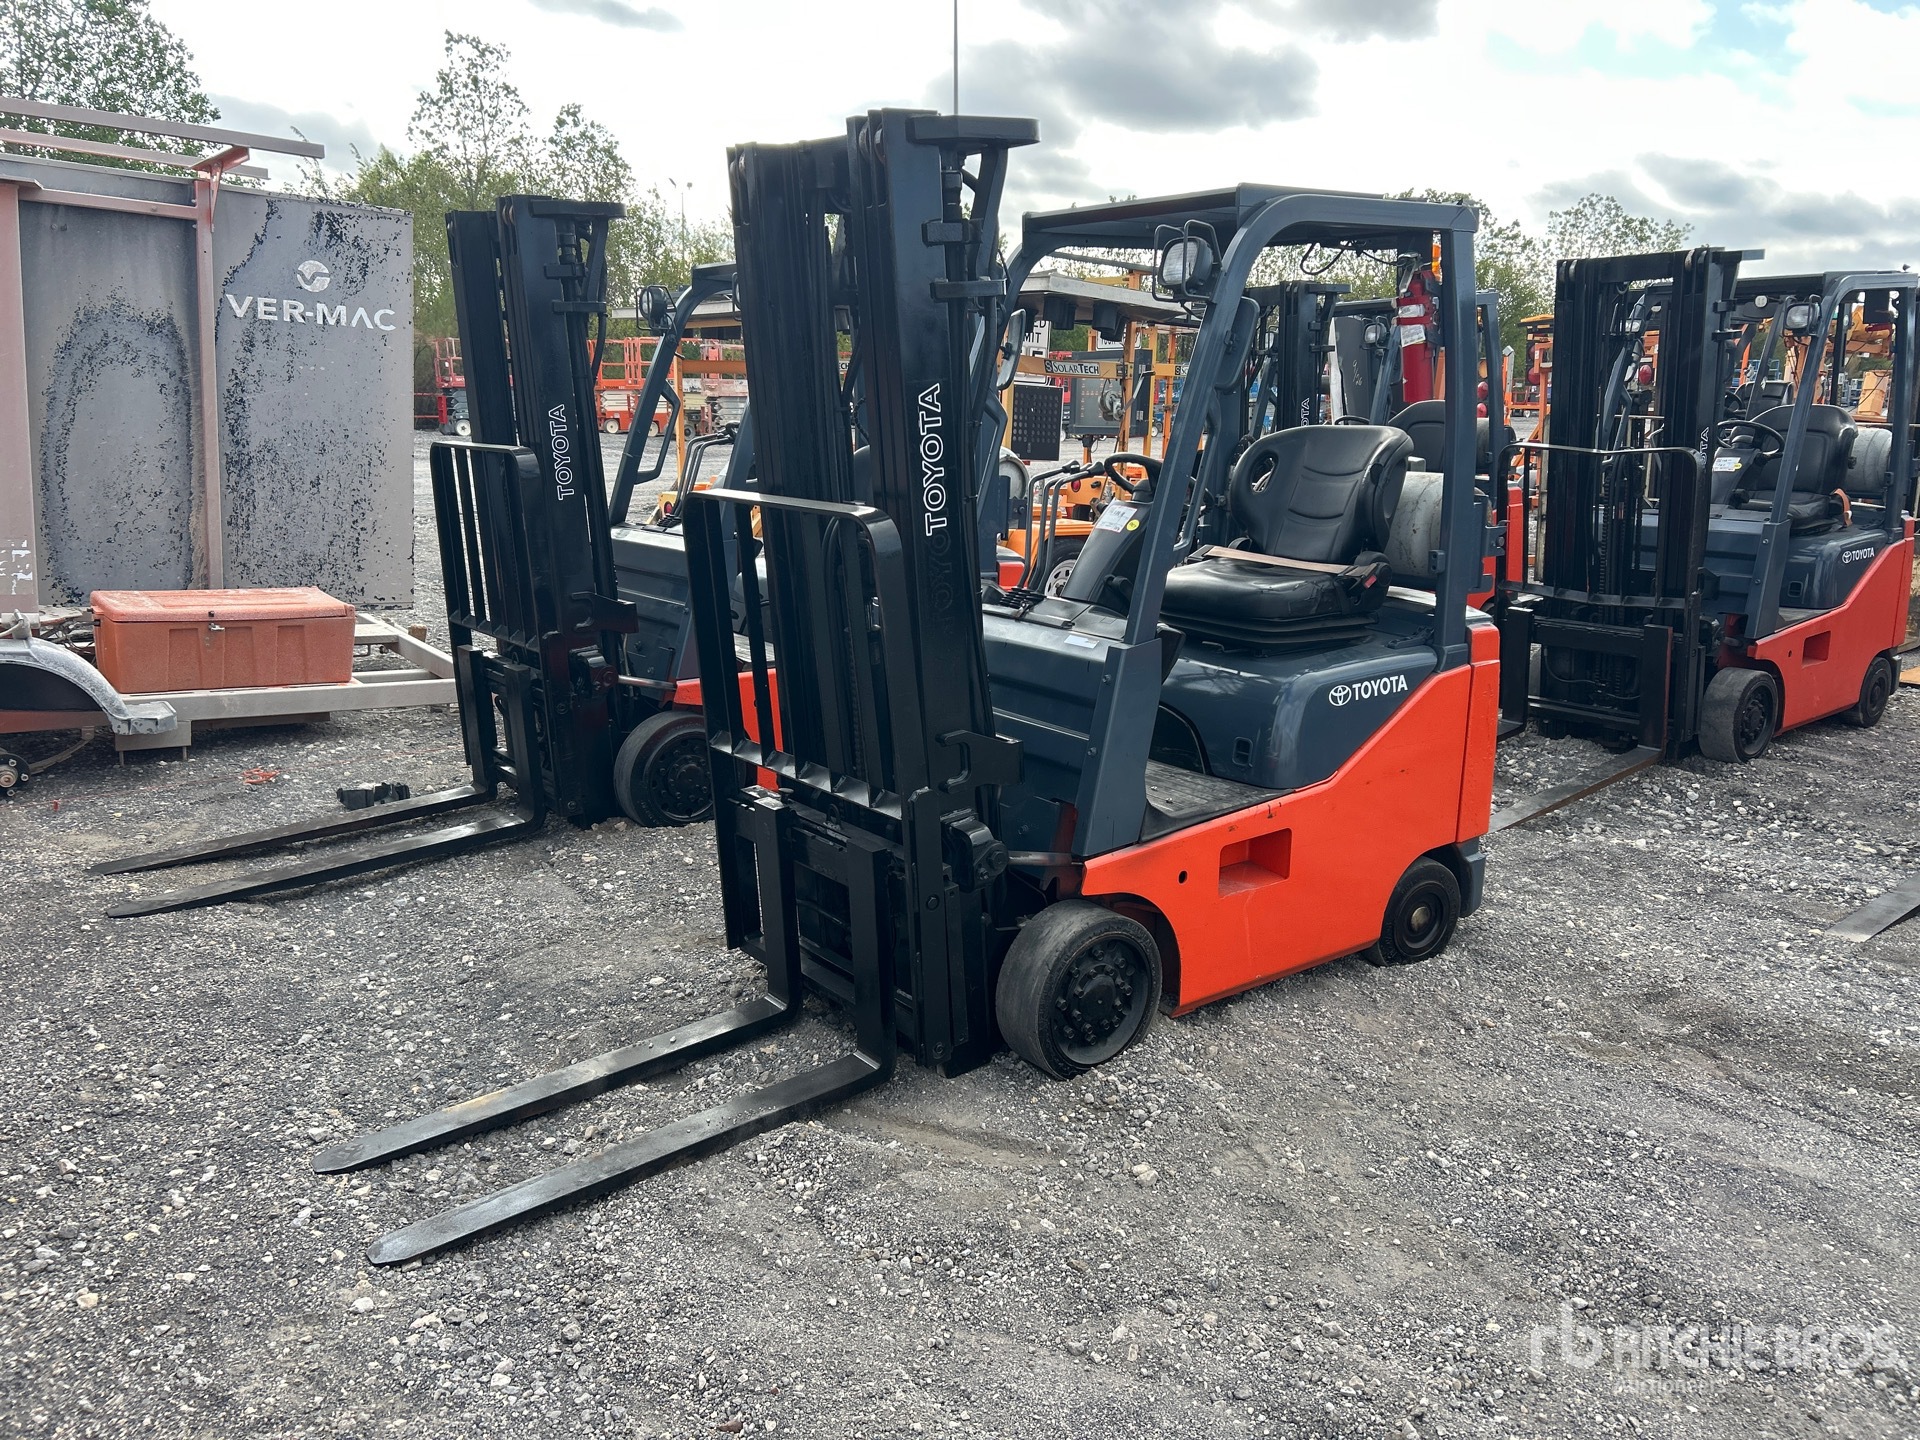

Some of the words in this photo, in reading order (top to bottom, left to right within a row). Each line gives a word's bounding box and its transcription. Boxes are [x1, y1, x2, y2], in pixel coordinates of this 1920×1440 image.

[225, 293, 397, 331] VER-MAC
[1024, 331, 1042, 343] MIT
[1301, 397, 1310, 427] OTA
[548, 404, 575, 501] TOYOTA
[918, 382, 948, 537] TOYOTA
[1852, 547, 1875, 561] TOYOTA
[1352, 674, 1408, 701] TOYOTA
